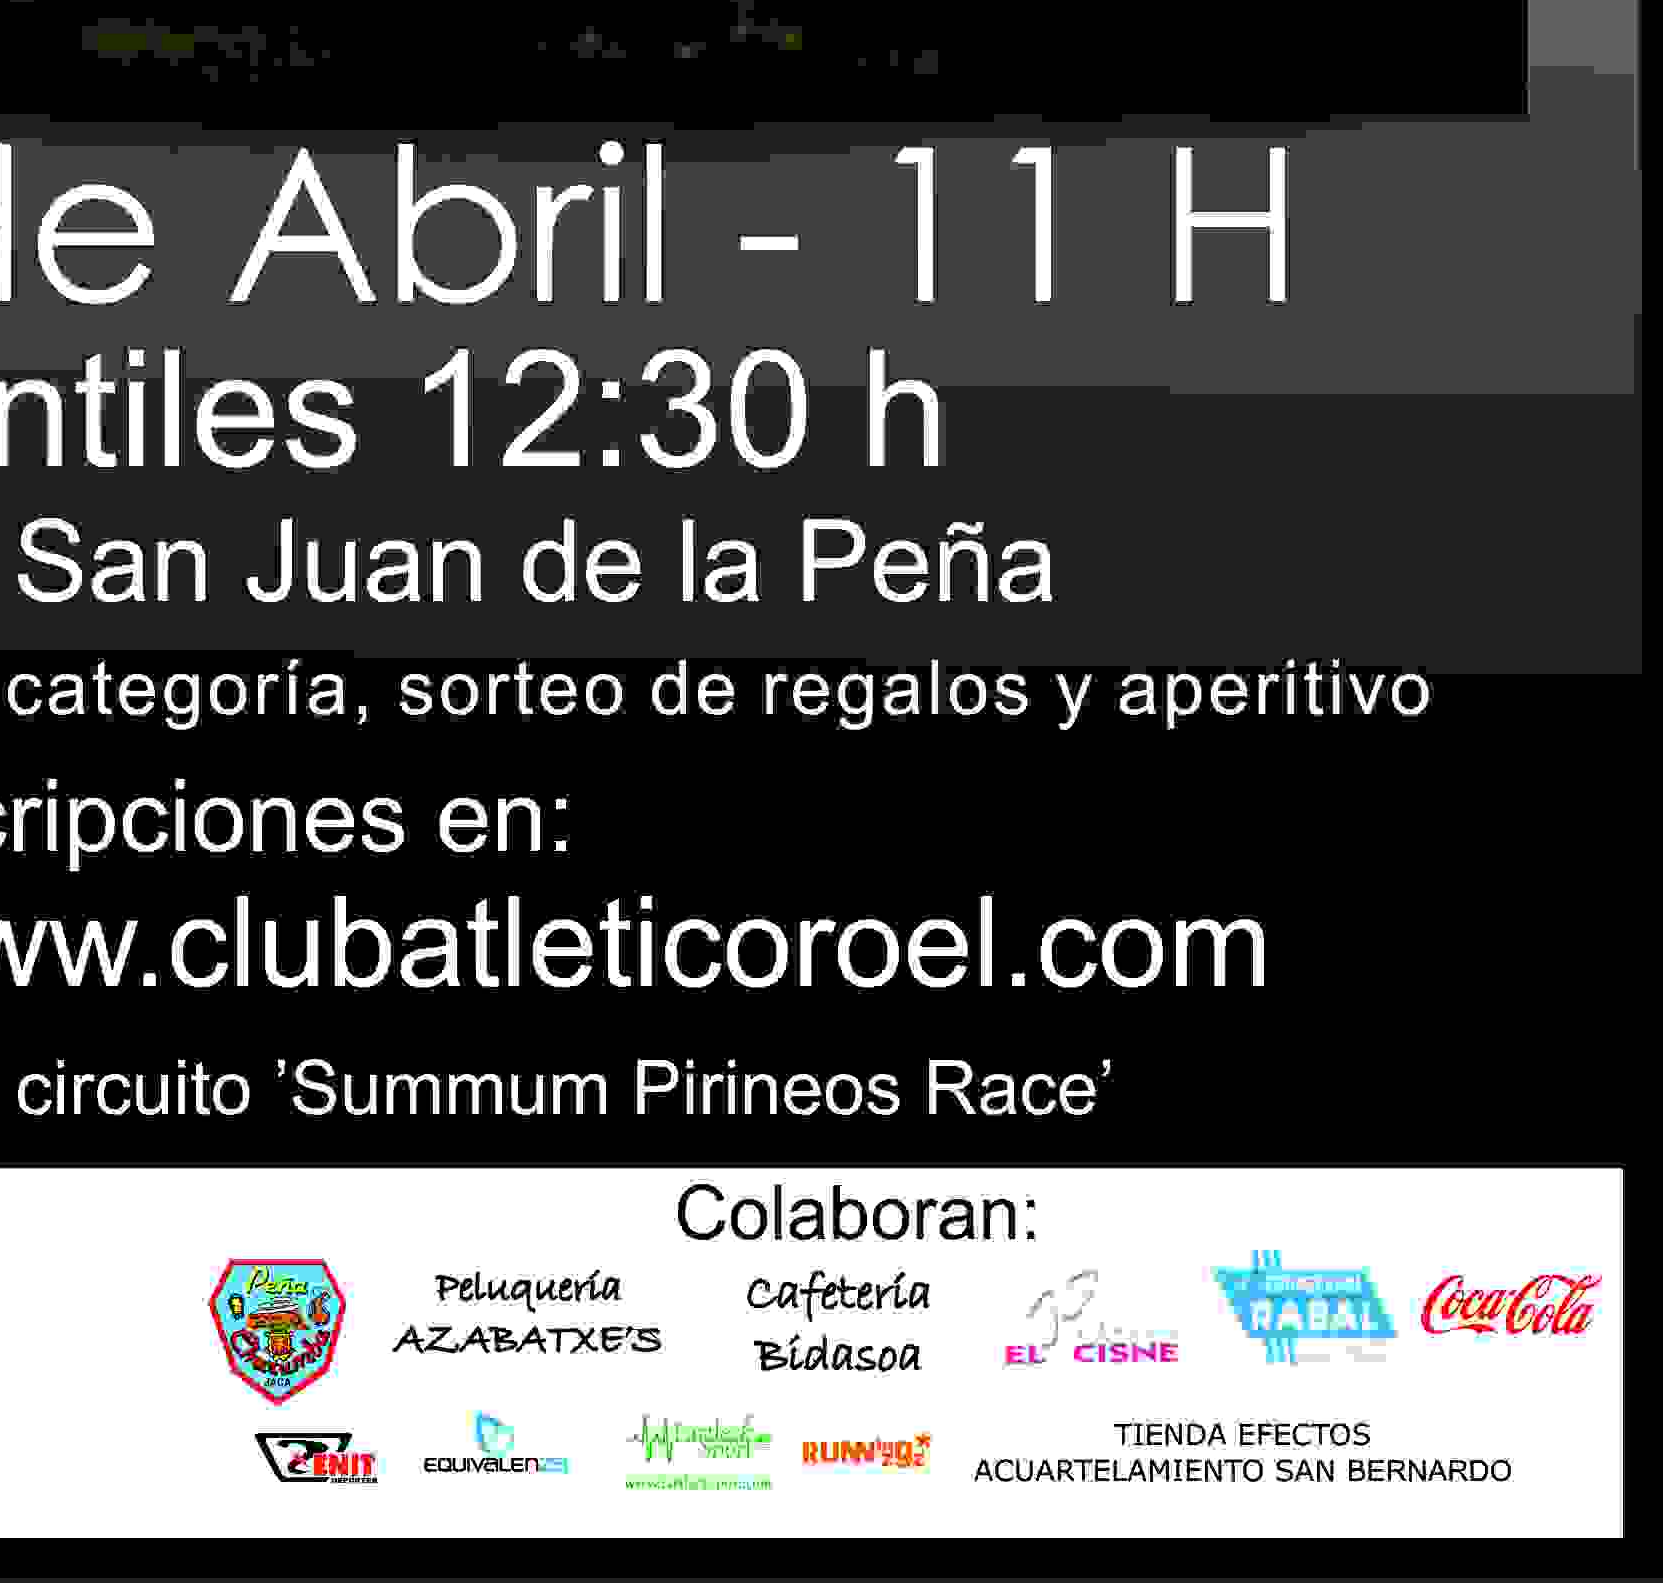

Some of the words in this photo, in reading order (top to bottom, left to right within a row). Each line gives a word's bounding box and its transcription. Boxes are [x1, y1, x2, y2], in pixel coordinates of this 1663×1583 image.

[230, 141, 661, 303] Abril
[741, 236, 798, 250] -
[895, 146, 1051, 301] 11
[1176, 146, 1285, 301] H
[425, 349, 806, 468] 12:30
[870, 349, 938, 466] h
[18, 518, 205, 602] San
[248, 518, 481, 602] Juan
[523, 519, 640, 602] de
[683, 520, 759, 602] la
[804, 519, 1052, 602] Peña
[8, 659, 366, 730] categoría,
[400, 663, 622, 715] sorteo
[652, 660, 734, 715] de
[766, 660, 1027, 730] regalos
[1057, 674, 1091, 730] y
[1120, 658, 1428, 730] aperitivo
[440, 798, 566, 852] en:
[18, 1060, 249, 1115] circuito
[637, 1060, 899, 1115] Pirineos
[678, 1184, 1034, 1240] Colaboran:
[436, 1270, 622, 1314] Peluquería
[746, 1270, 930, 1322] Cafetería
[1005, 1345, 1042, 1363] EL
[1073, 1344, 1179, 1363] CISNE
[1114, 1422, 1226, 1446] TIENDA
[1240, 1422, 1370, 1446] EFECTOS
[975, 1459, 1262, 1482] ACUARTELAMIENTO
[1274, 1459, 1333, 1482] SAN
[1349, 1459, 1511, 1482] BERNARDO
